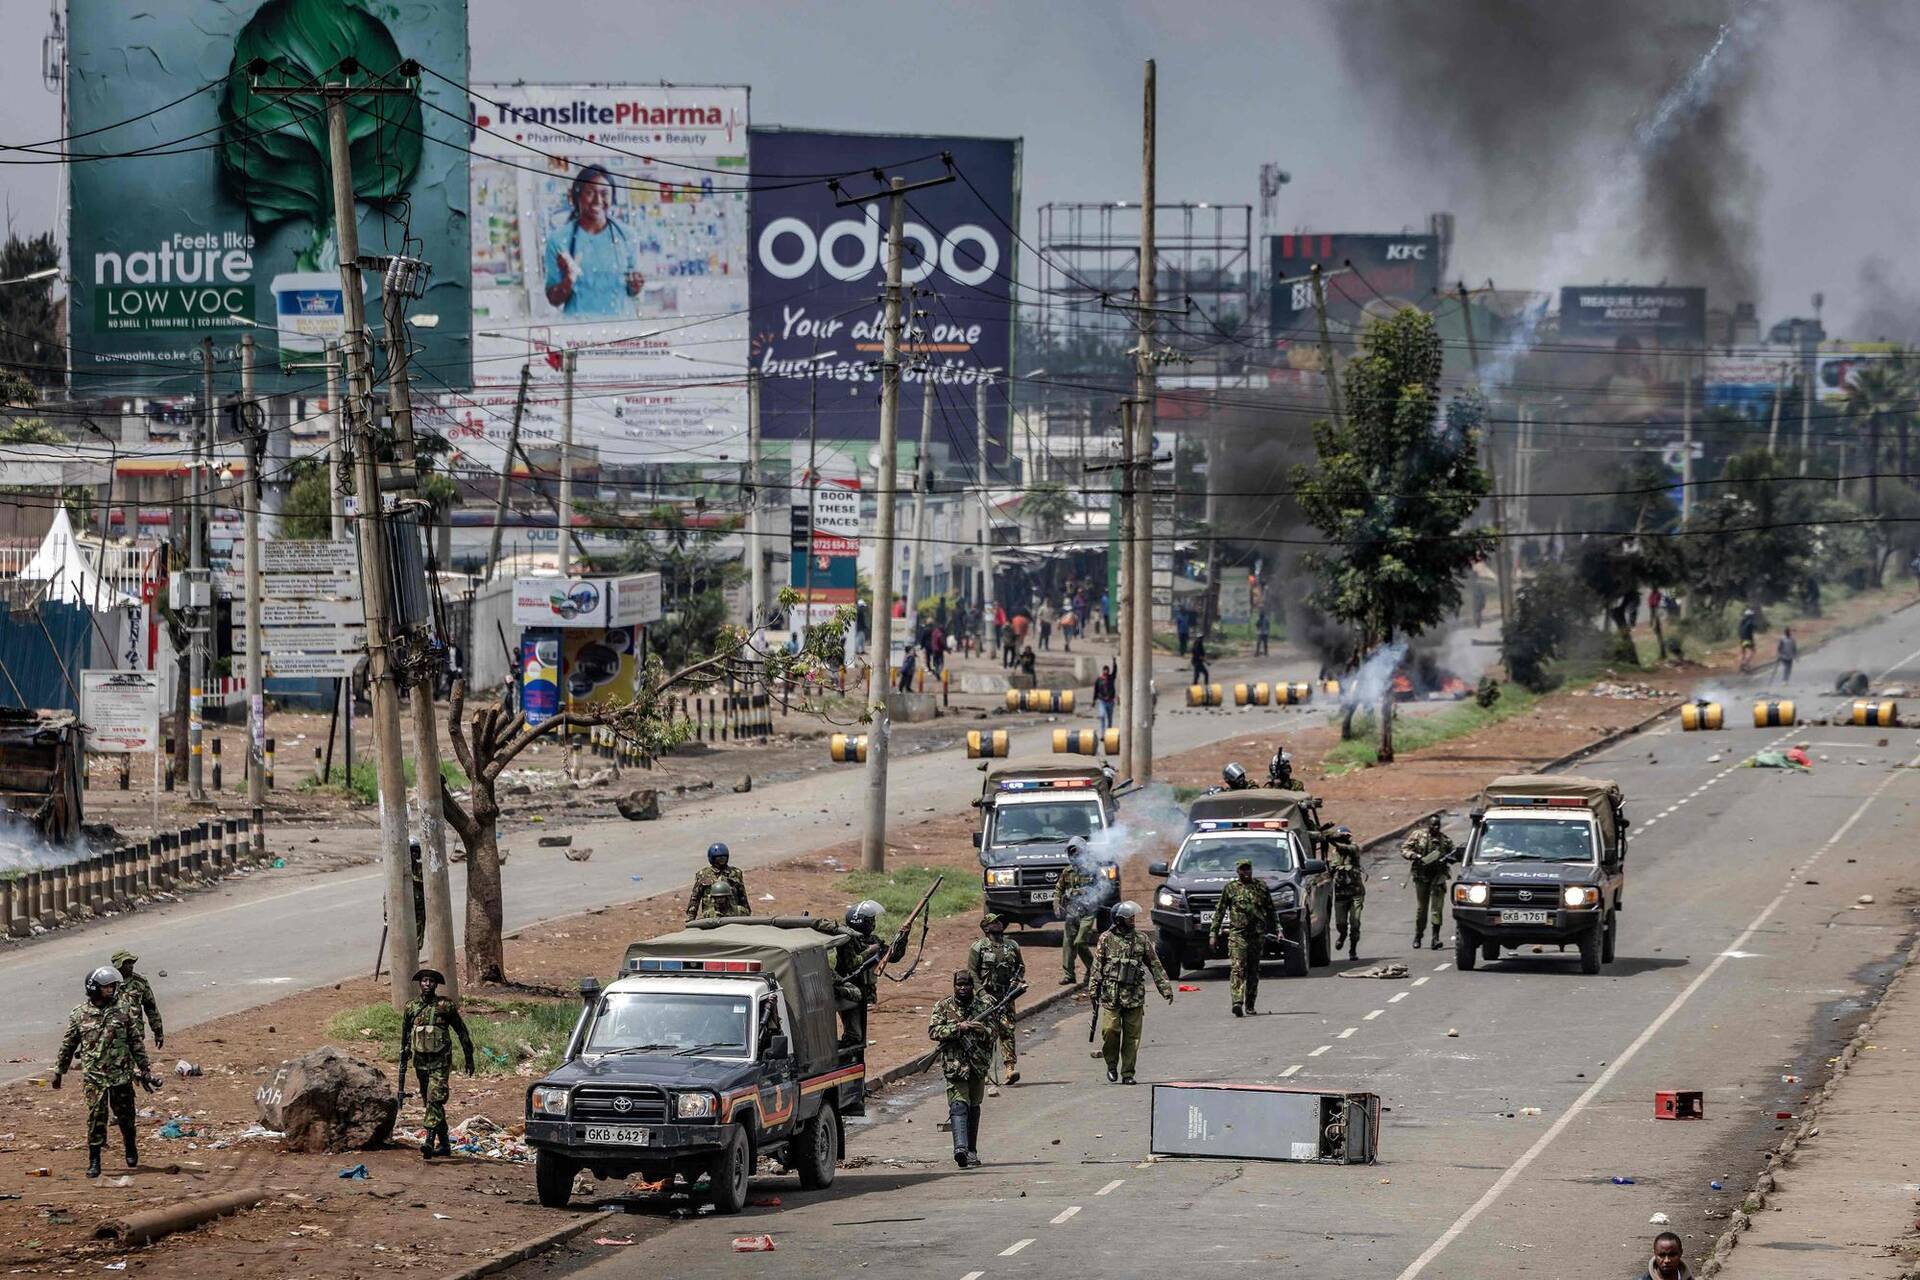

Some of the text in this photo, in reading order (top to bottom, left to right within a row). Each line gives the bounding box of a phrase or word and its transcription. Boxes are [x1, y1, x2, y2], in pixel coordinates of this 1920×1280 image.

[494, 102, 721, 125] TranslitePharma
[527, 133, 707, 146] Pharmacy Wellness Beauty
[173, 232, 255, 249] Feels like
[758, 203, 999, 286] odoo
[1386, 244, 1427, 260] KFC
[95, 240, 254, 285] nature
[108, 288, 244, 315] LOW VOC
[108, 320, 118, 329] NO
[119, 319, 141, 329] SMELL
[151, 318, 172, 328] TOXIN
[172, 318, 189, 328] FREE
[198, 317, 211, 327] ECO
[783, 305, 843, 340] Your
[932, 324, 983, 344] one
[95, 350, 187, 364] crownpaints.co.ke
[761, 348, 876, 383] business
[820, 492, 854, 501] BOOK
[817, 504, 856, 514] THESE
[814, 517, 860, 527] SPACES
[256, 1086, 282, 1105] MA
